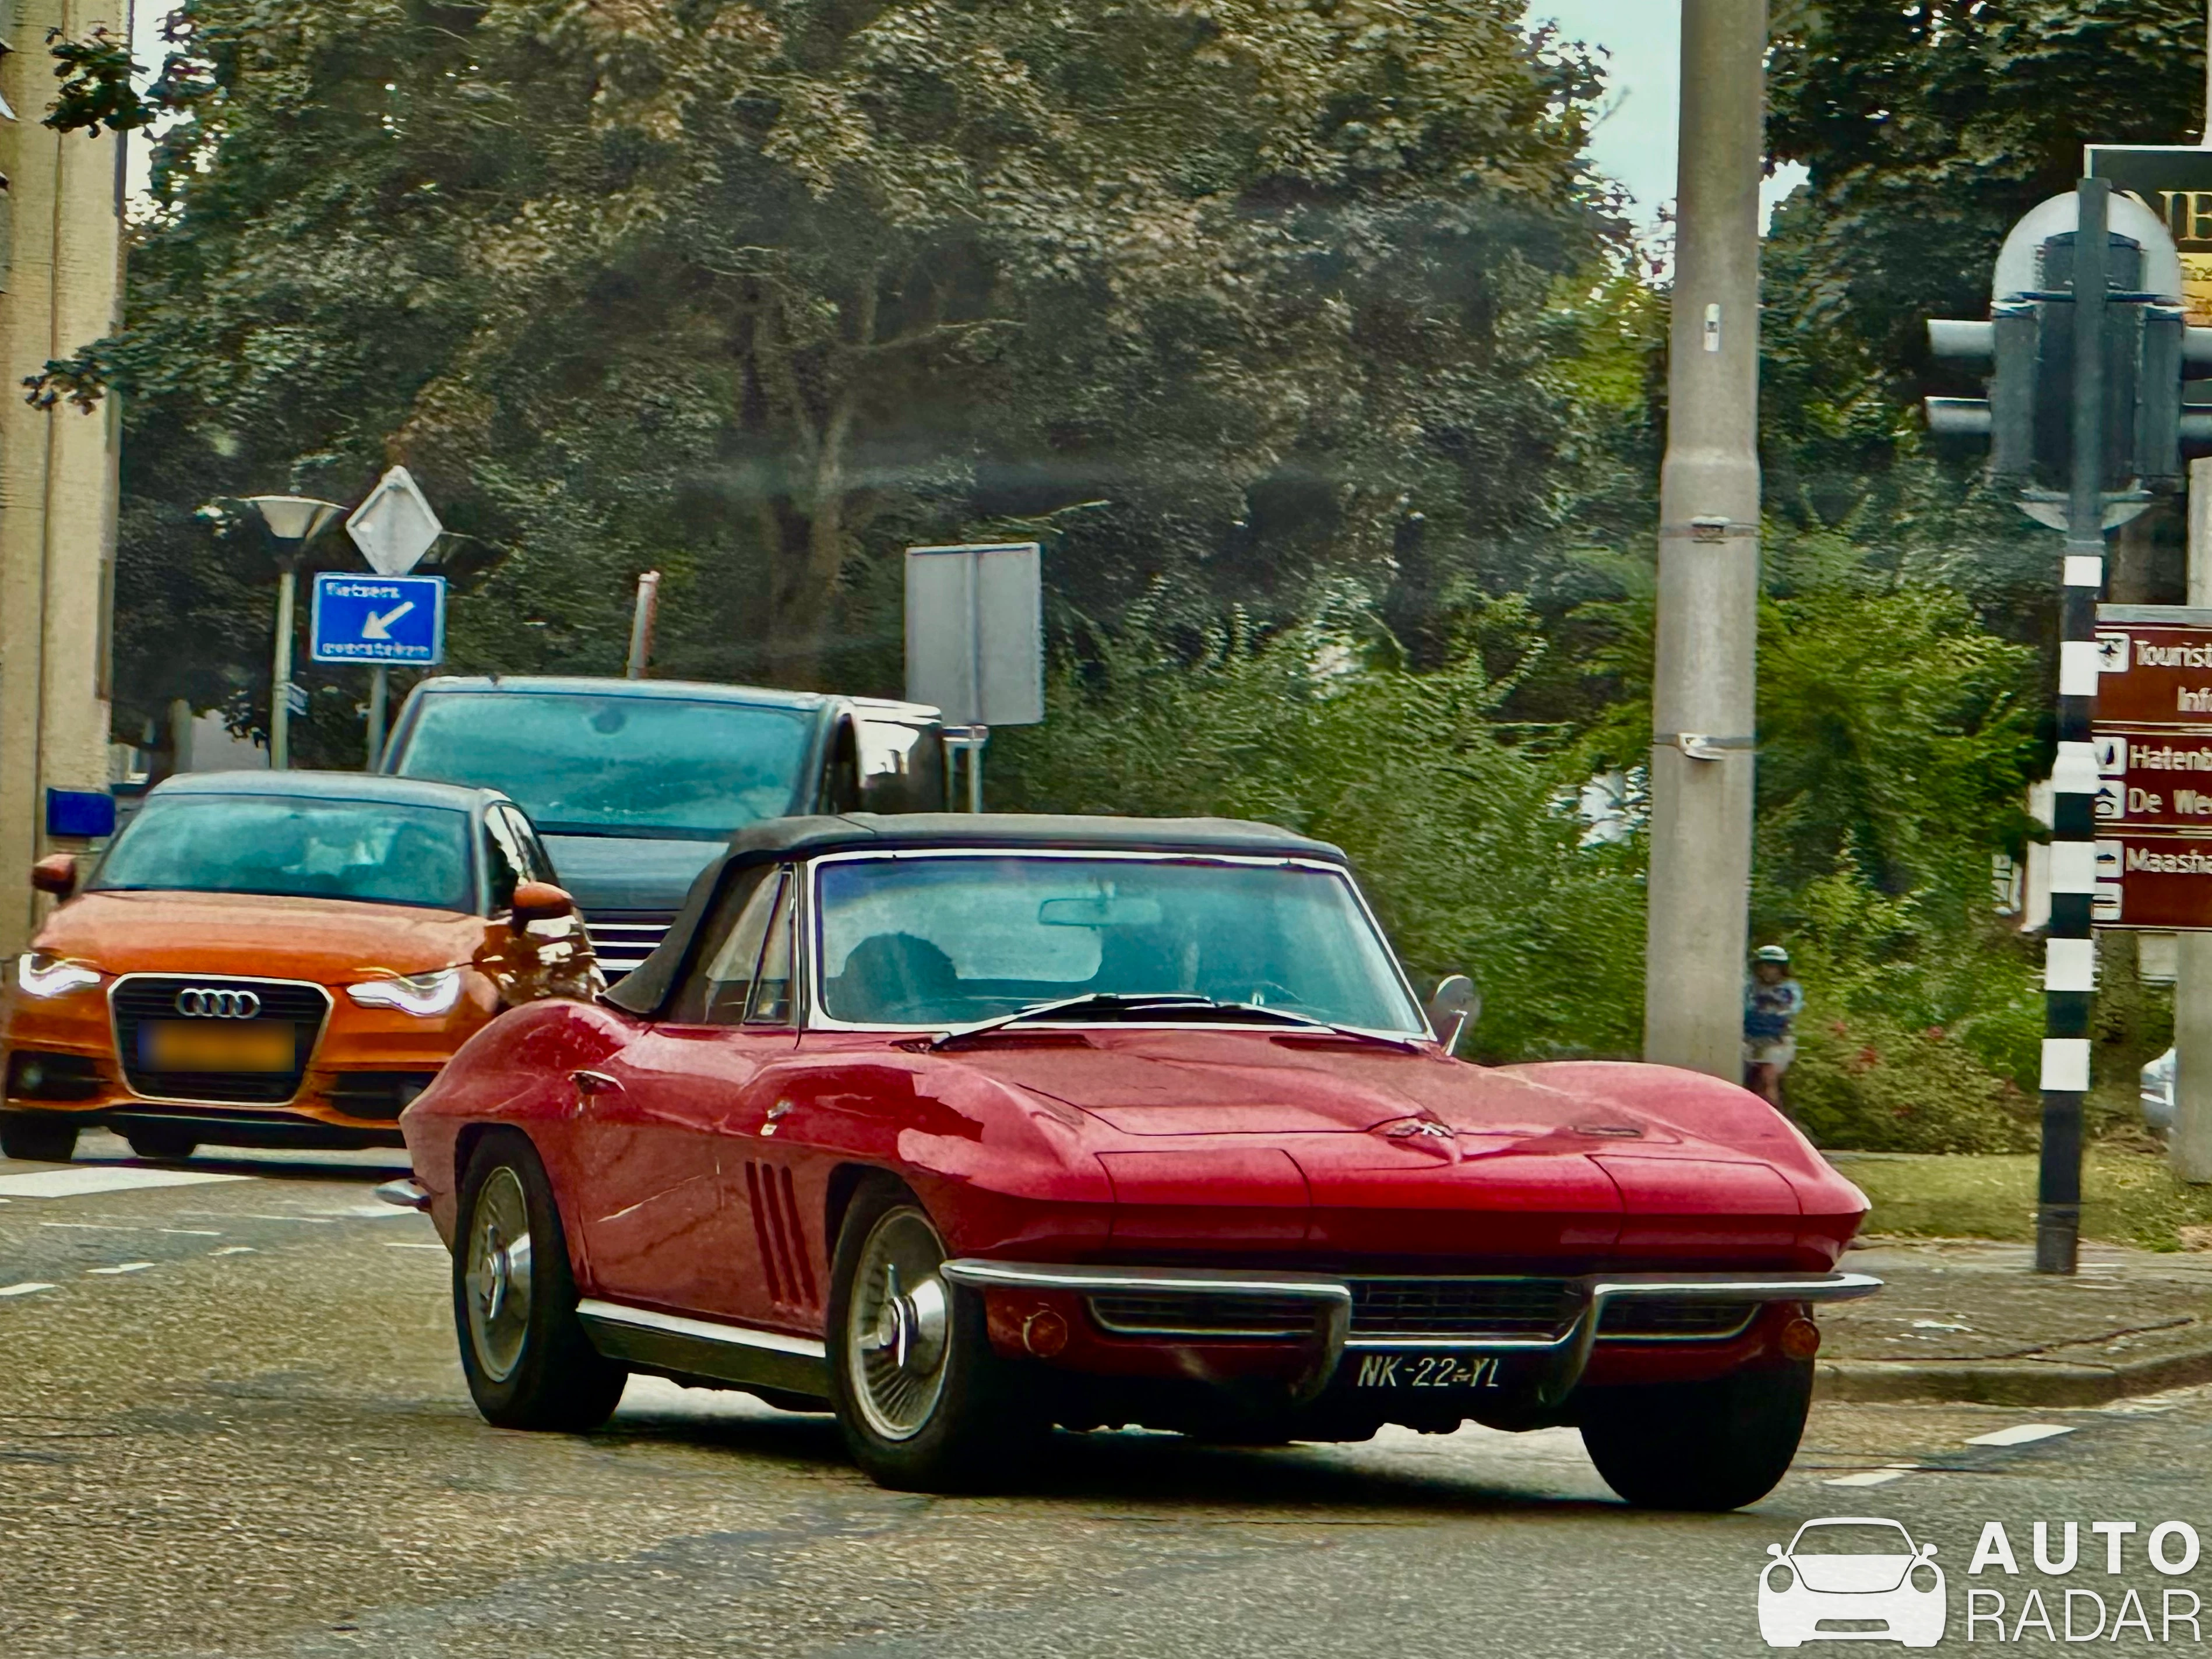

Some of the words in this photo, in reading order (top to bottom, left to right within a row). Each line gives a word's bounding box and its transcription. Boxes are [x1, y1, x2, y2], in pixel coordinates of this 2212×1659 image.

[2176, 685, 2212, 712] Inf
[2128, 787, 2163, 813] De
[2173, 789, 2212, 815] We
[1357, 1355, 1499, 1387] NK-22-YL
